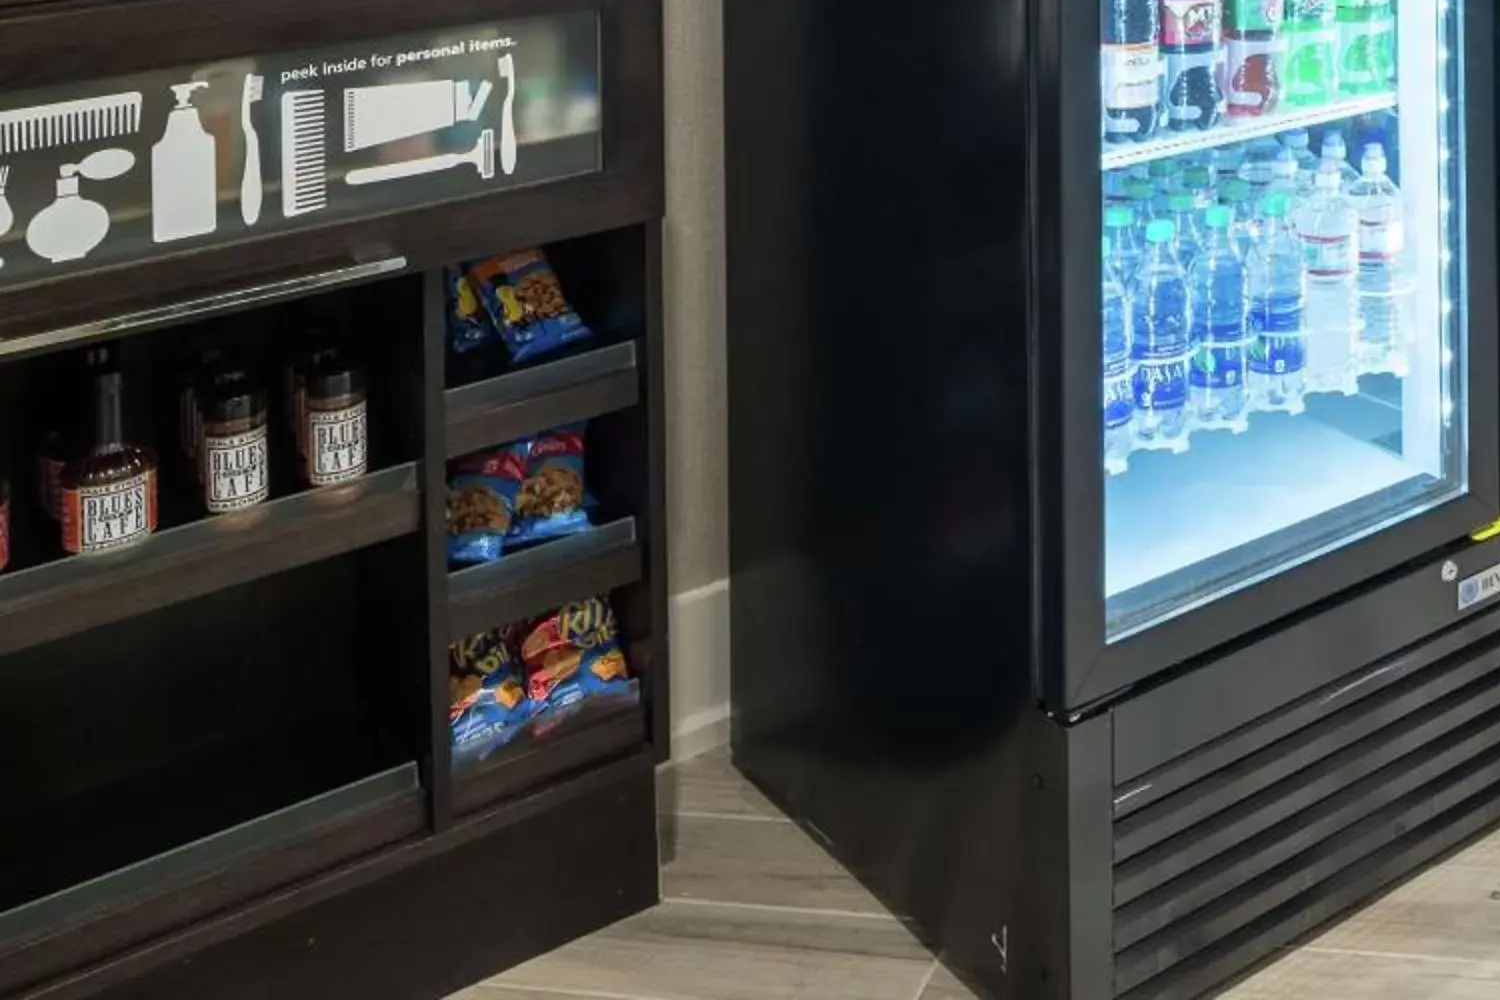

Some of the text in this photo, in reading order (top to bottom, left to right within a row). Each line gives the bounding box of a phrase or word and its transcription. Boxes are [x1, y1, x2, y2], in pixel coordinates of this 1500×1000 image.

[281, 36, 518, 84] peek inside for personal items.
[213, 443, 266, 471] BLUES
[87, 487, 143, 521] BLUES
